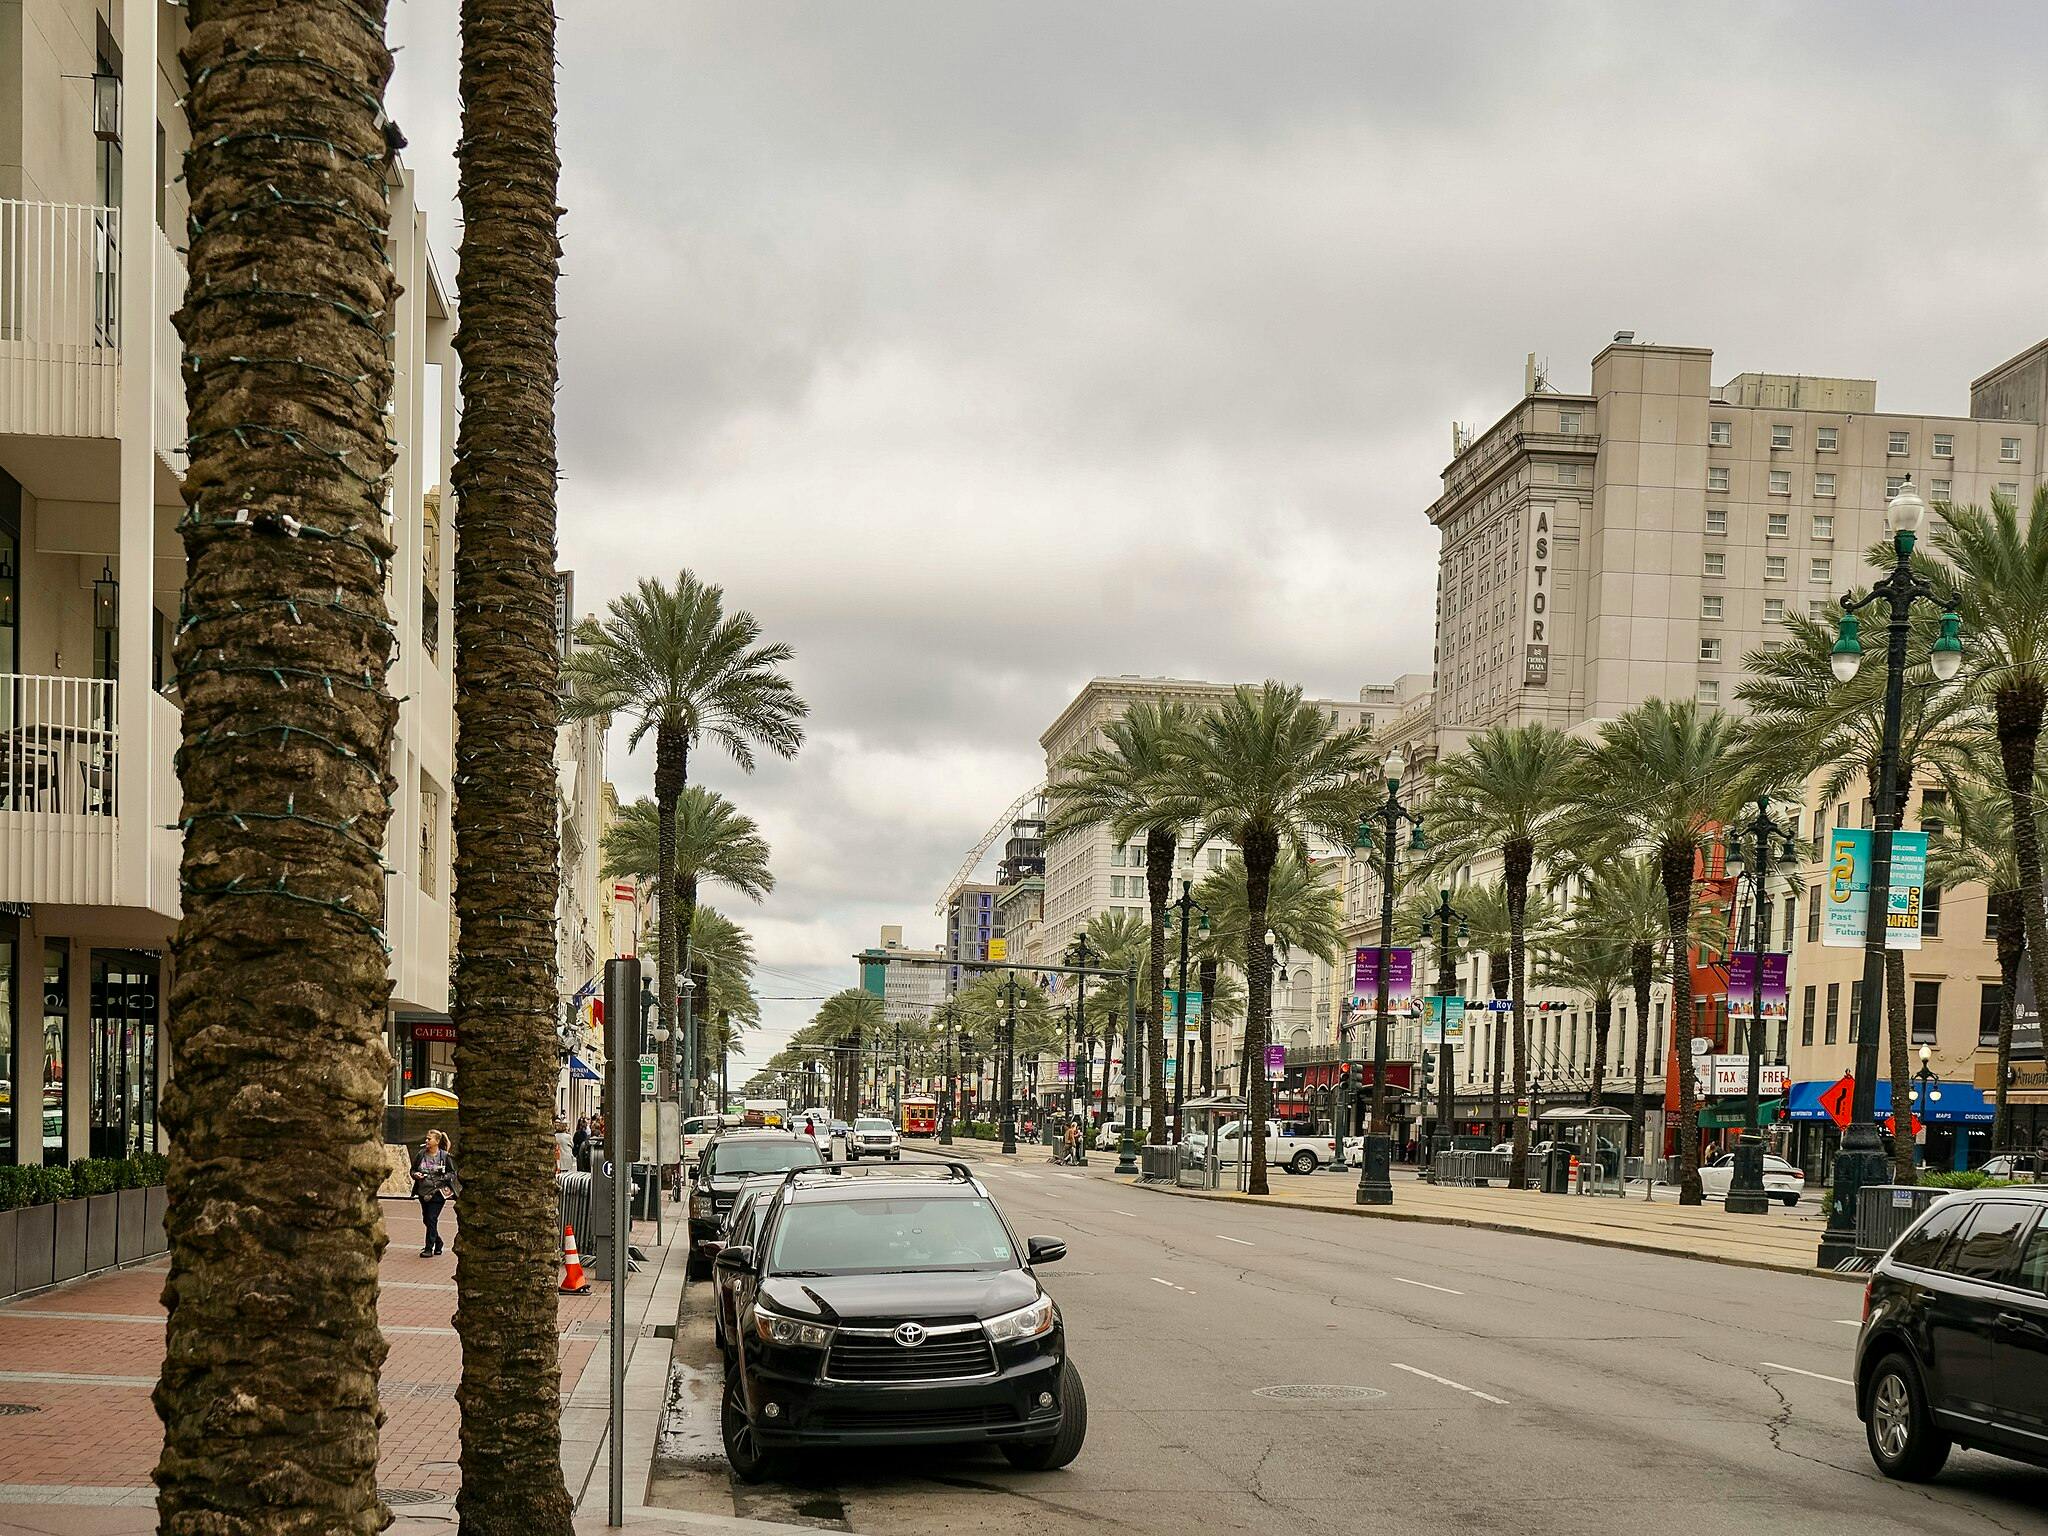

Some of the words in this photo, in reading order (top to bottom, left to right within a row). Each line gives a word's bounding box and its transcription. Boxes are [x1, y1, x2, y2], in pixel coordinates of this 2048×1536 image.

[1533, 511, 1549, 641] ASTOR
[1909, 887, 1920, 914] EXPO
[1831, 913, 1852, 921] Past
[1887, 914, 1918, 928] RAFFIC
[1836, 928, 1867, 937] Future
[641, 1056, 655, 1064] ARK
[1718, 1071, 1736, 1083] TAX
[1762, 1071, 1786, 1083] FREE
